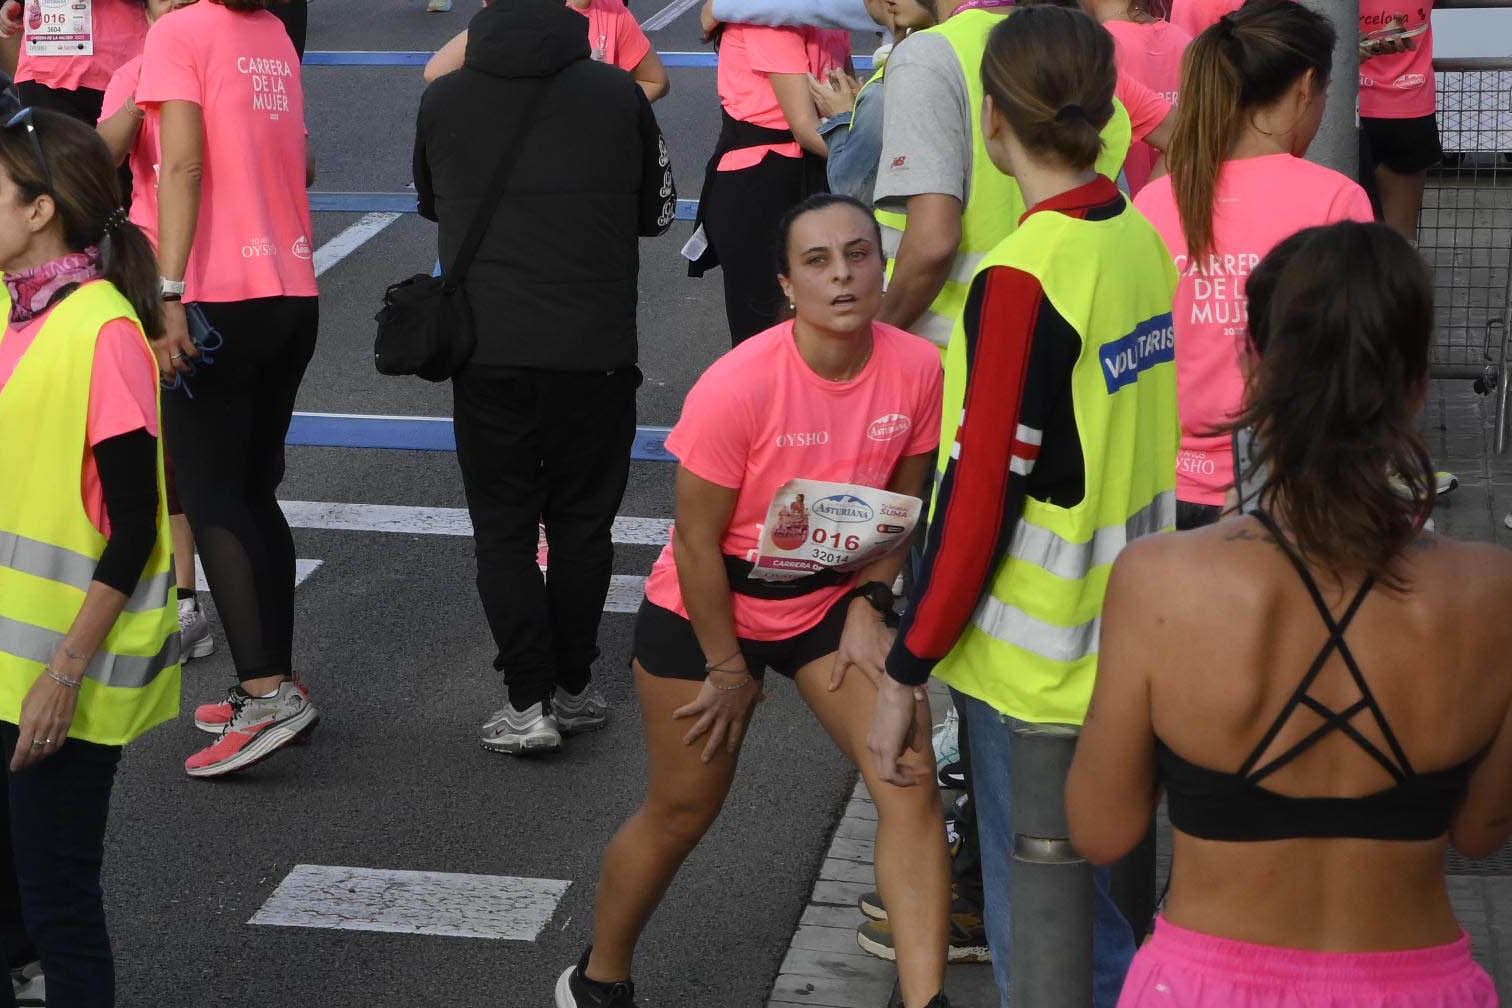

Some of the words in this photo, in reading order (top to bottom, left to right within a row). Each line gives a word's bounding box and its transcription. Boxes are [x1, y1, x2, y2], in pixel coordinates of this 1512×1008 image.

[44, 13, 66, 23] 016
[238, 56, 292, 77] CARRERA
[253, 76, 269, 92] DE
[272, 77, 285, 93] LA
[253, 94, 289, 112] MUJER
[1195, 278, 1226, 300] DE
[776, 431, 829, 448] OYSHO
[817, 503, 869, 519] ASTURIANA
[880, 508, 908, 518] SUMA
[812, 528, 860, 551] 016
[773, 560, 811, 569] CARRERA
[812, 549, 849, 563] 32014
